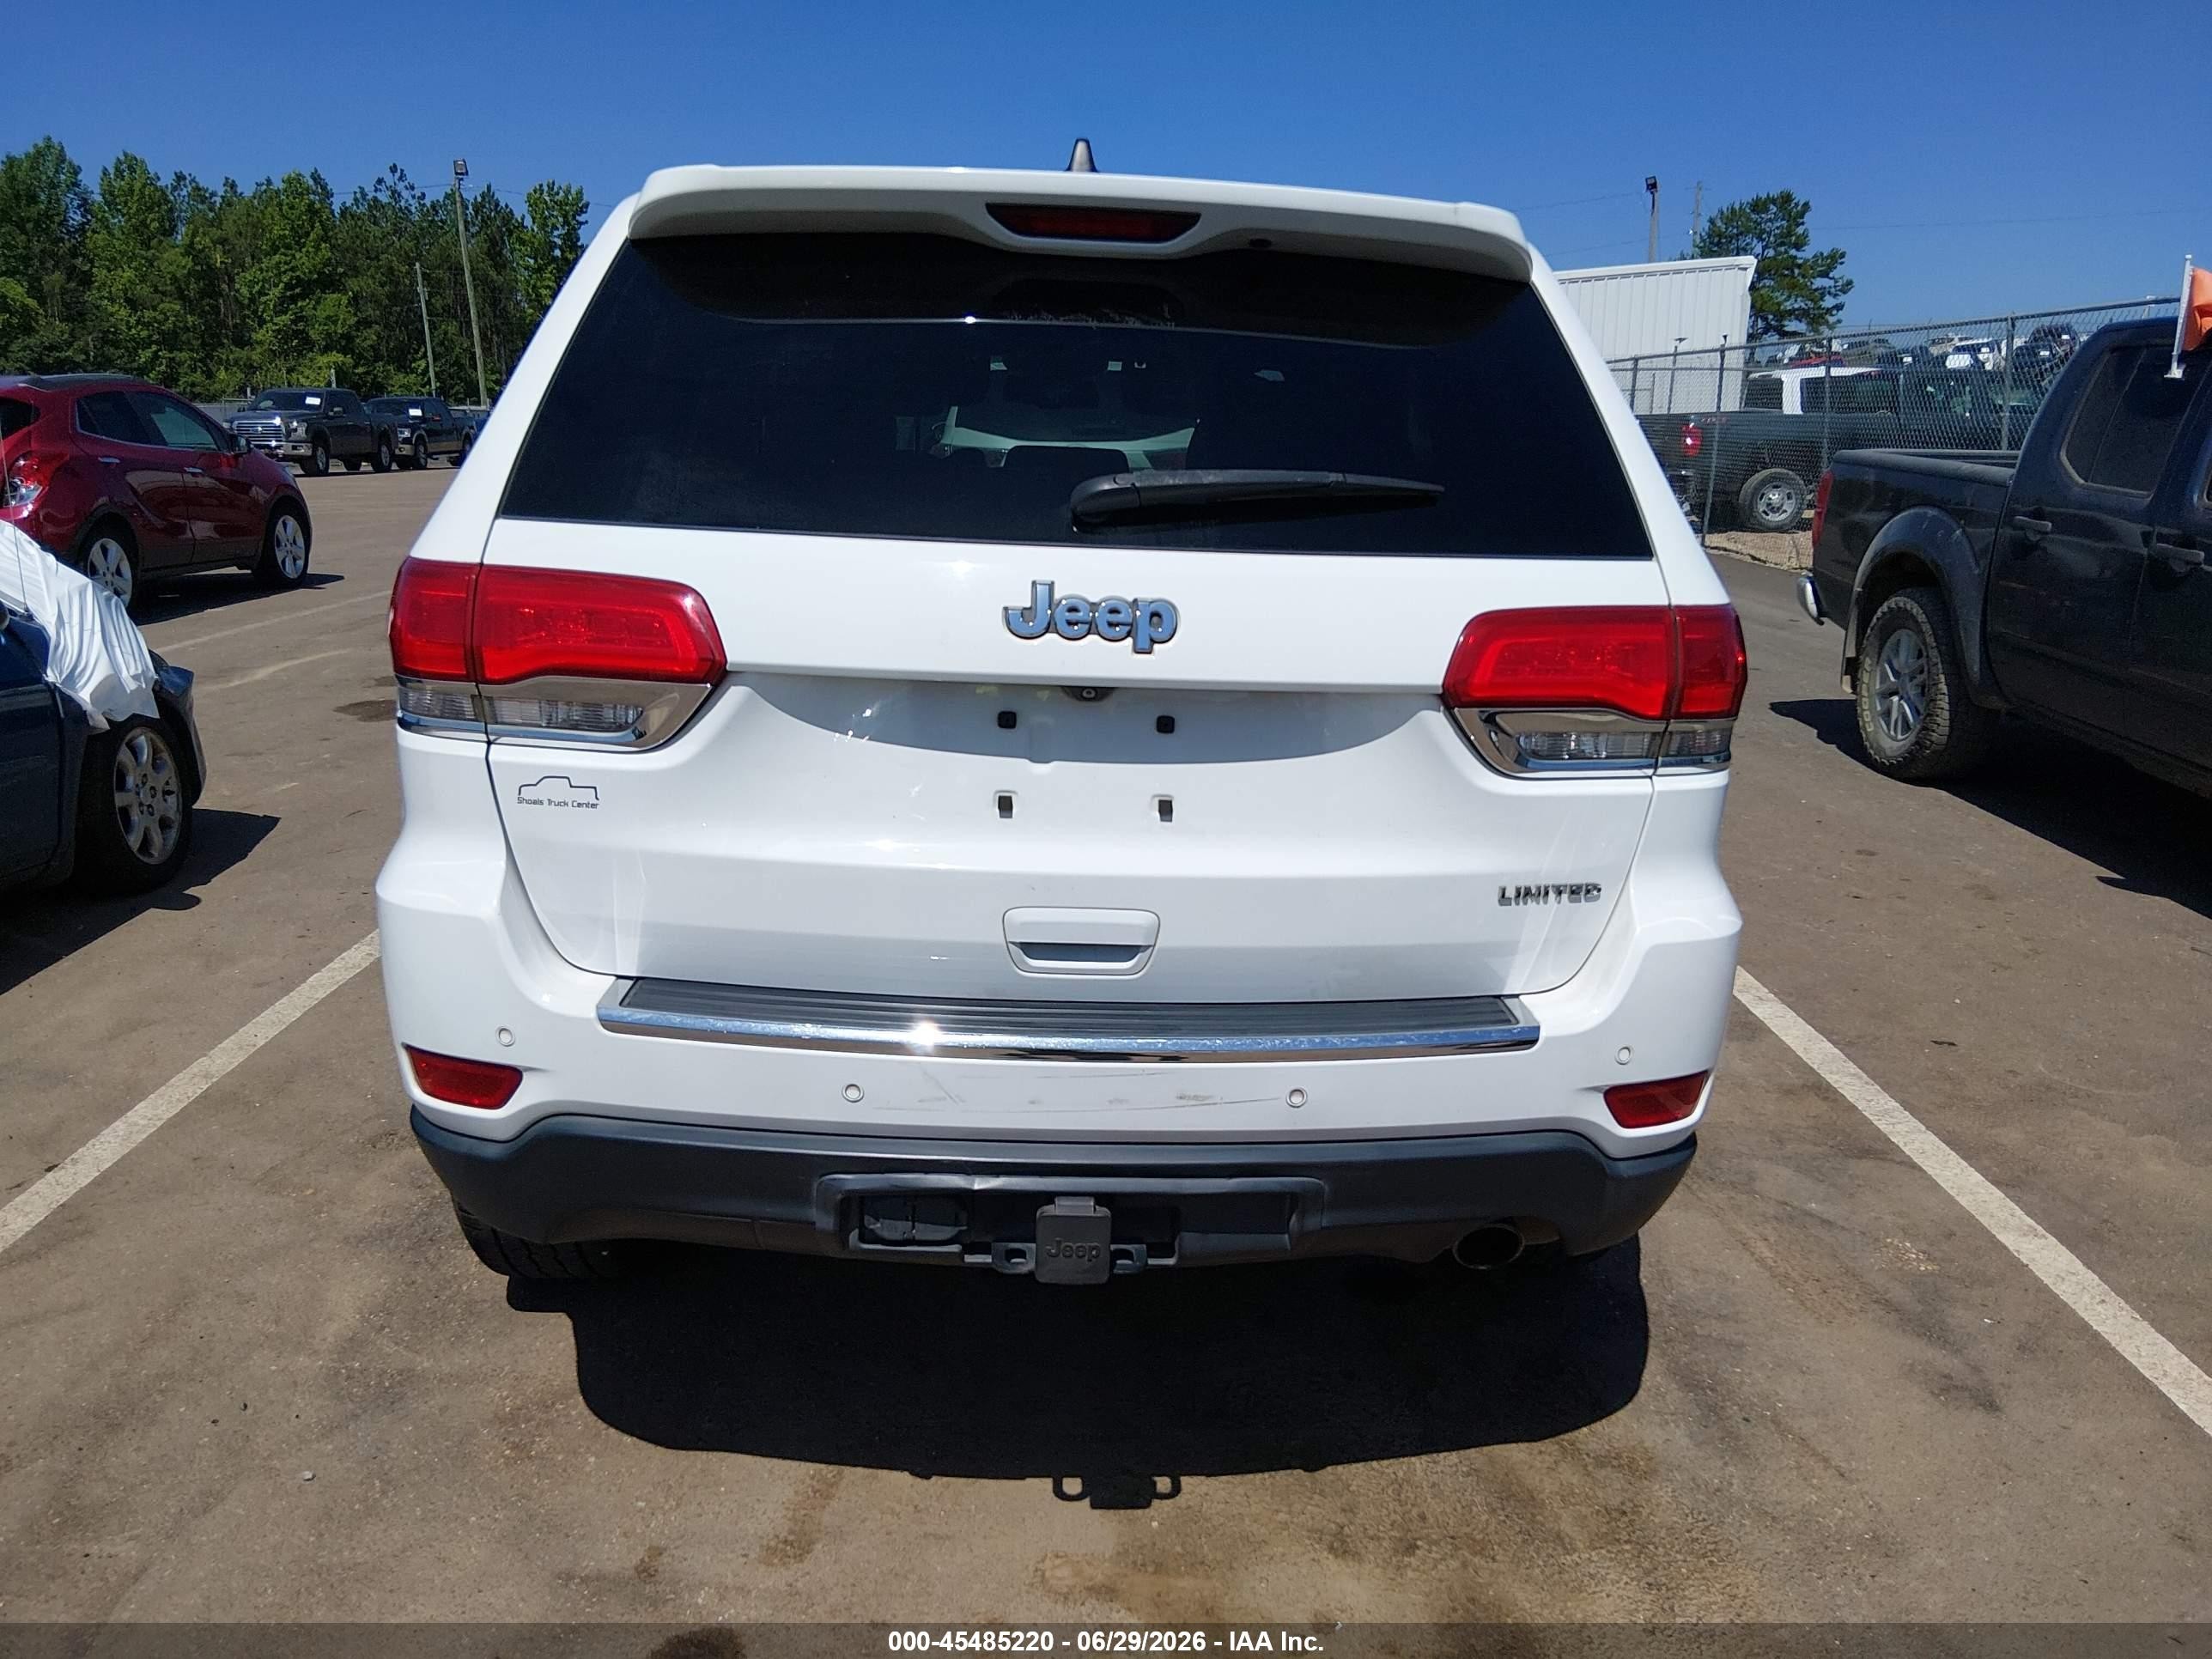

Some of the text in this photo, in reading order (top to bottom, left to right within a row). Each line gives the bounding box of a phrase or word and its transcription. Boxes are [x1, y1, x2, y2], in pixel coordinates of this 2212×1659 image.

[1003, 580, 1178, 654] Jeep
[517, 796, 599, 809] Shoals Truck Center
[1498, 883, 1601, 906] LIMITED
[1046, 1237, 1101, 1262] Jeep
